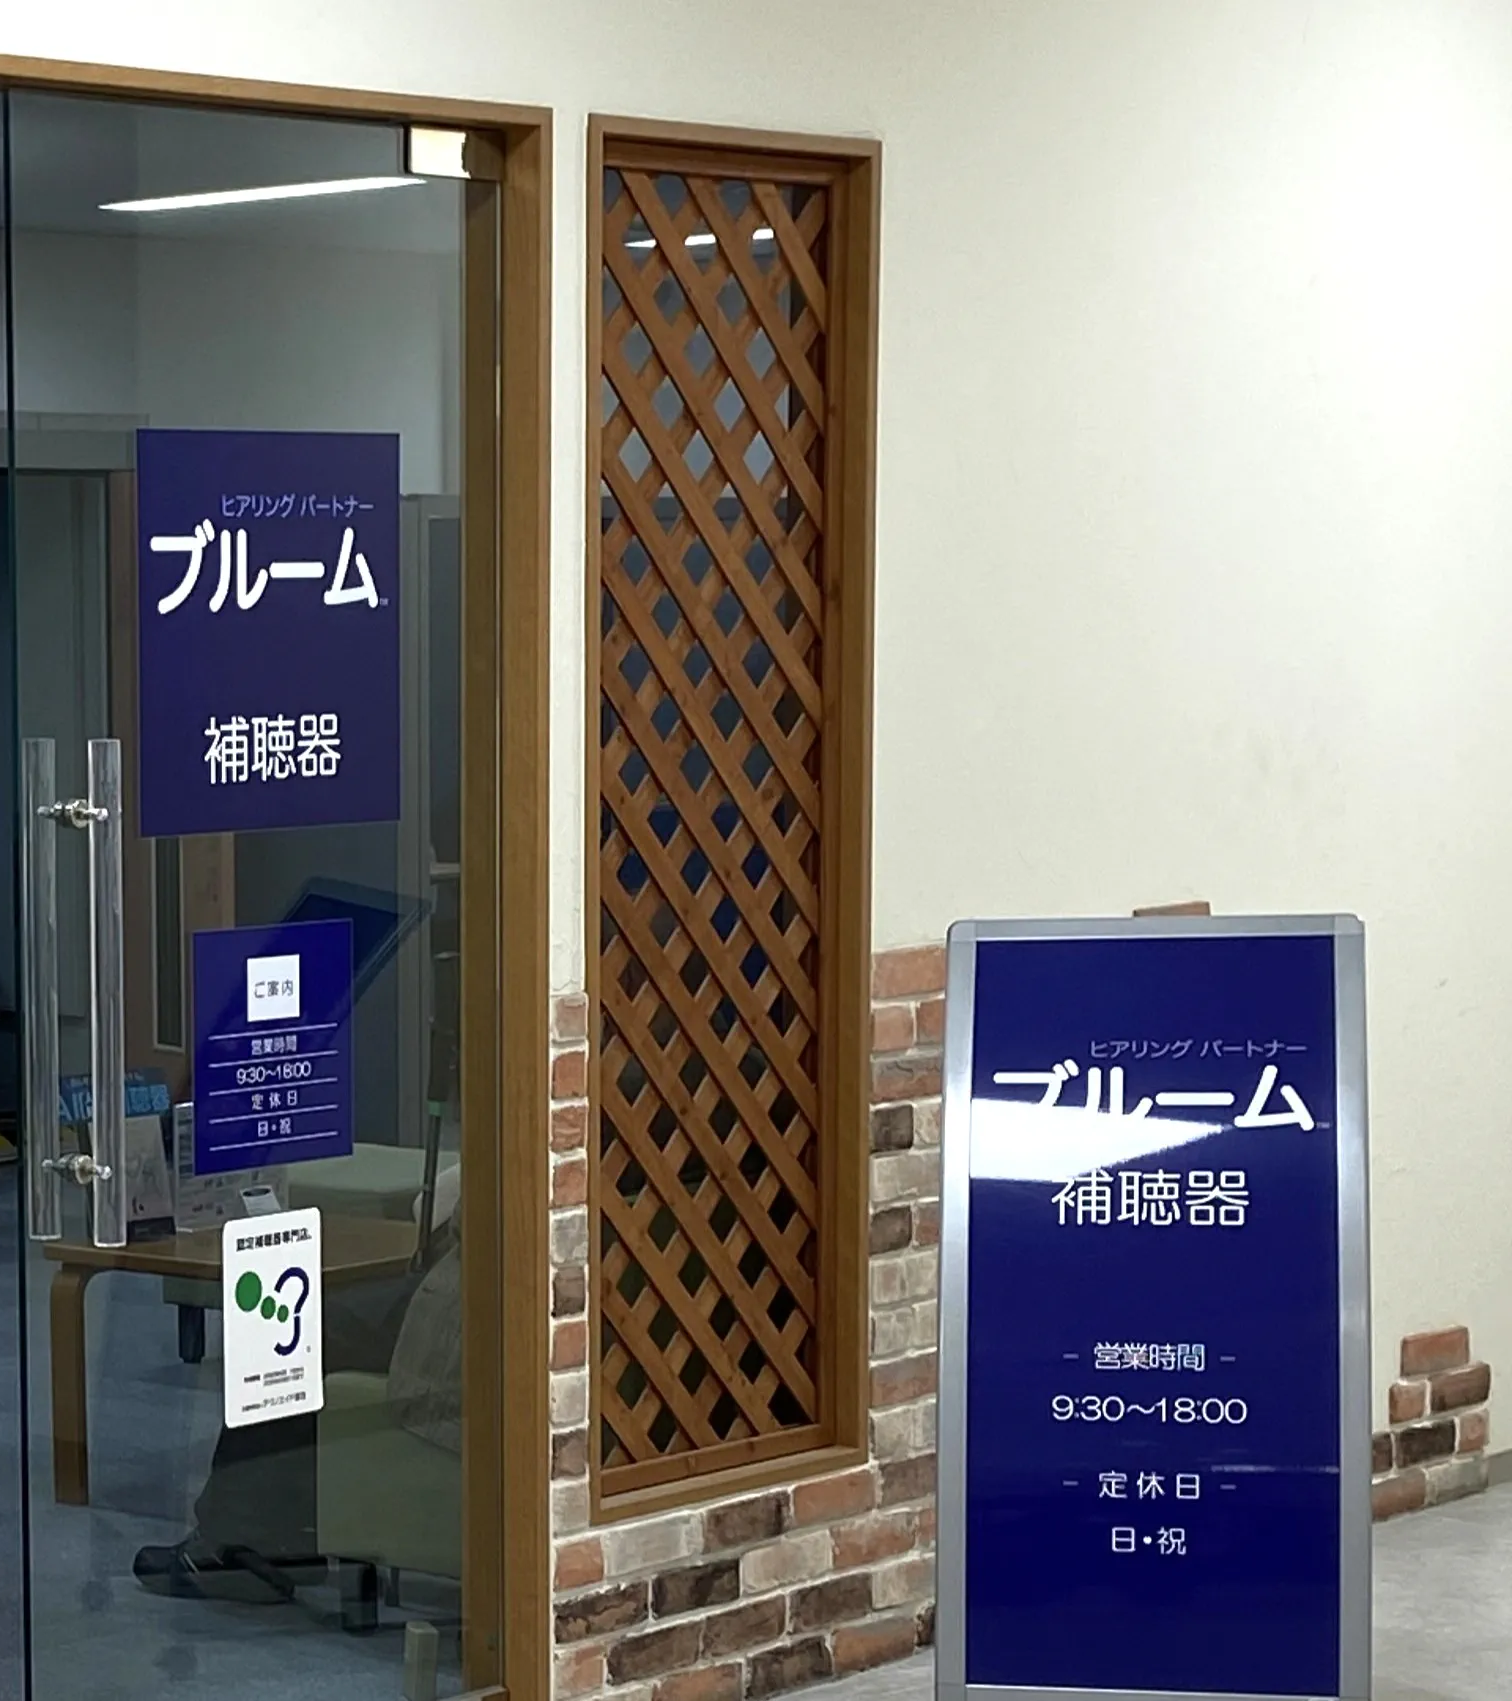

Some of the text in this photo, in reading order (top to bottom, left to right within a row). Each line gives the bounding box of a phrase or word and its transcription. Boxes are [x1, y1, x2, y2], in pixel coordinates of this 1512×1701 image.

[221, 494, 374, 519] ヒアリング パートナー
[149, 518, 380, 615] ブルーム
[203, 713, 342, 785] 補聴器
[253, 978, 294, 999] ご案内
[1089, 1039, 1308, 1060] ヒアリング パートナー
[1050, 1168, 1250, 1227] 補聴器
[1094, 1342, 1206, 1372] 営業時間
[1098, 1469, 1201, 1500] 定休日
[1110, 1526, 1188, 1556] 日・祝
